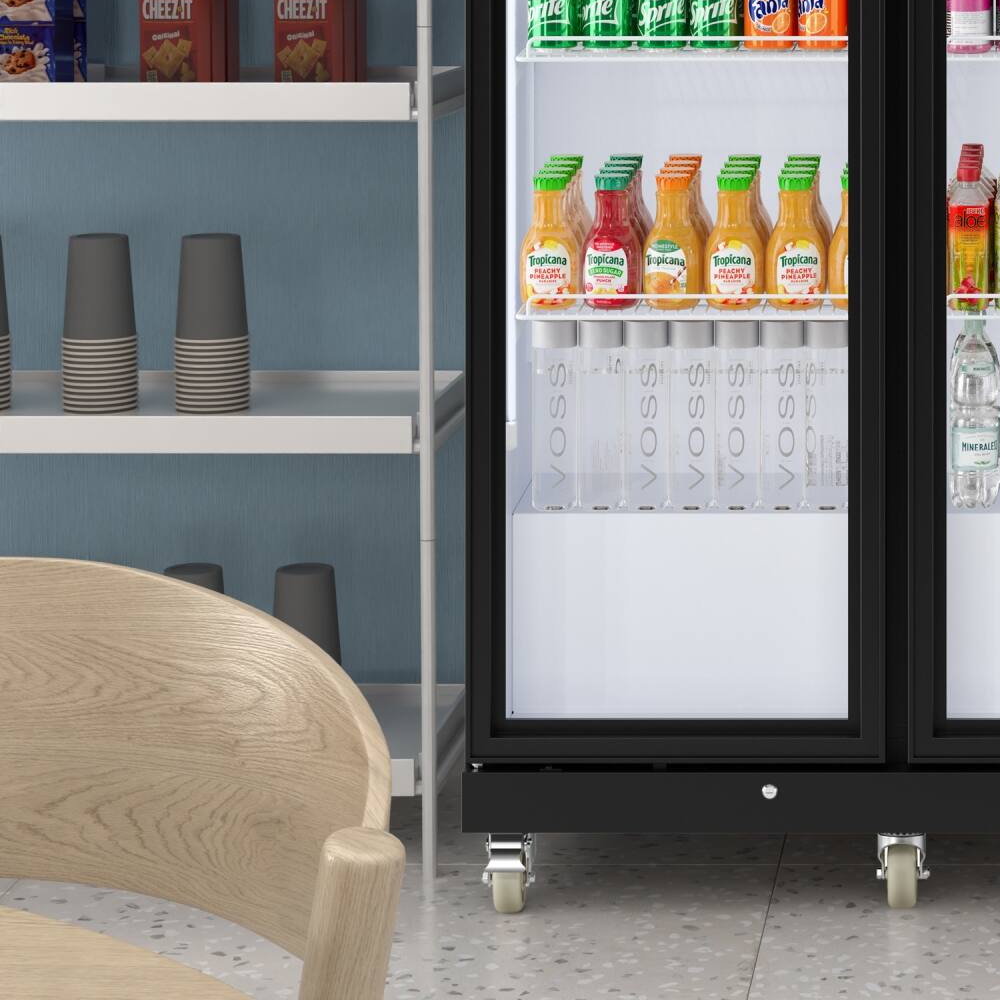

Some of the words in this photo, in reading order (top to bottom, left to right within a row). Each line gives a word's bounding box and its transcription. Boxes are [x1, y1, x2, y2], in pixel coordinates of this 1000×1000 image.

[955, 211, 986, 228] aloe
[528, 254, 567, 267] Tropicana
[587, 254, 624, 267] Tropicana
[646, 254, 685, 267] Tropicana
[713, 254, 751, 267] Tropicana
[780, 254, 818, 267] Tropicana
[603, 268, 623, 277] SUGAR
[550, 362, 567, 490] VOSS
[640, 362, 658, 490] VOSS
[688, 362, 705, 490] VOSS
[728, 362, 745, 490] VOSS
[778, 362, 795, 490] VOSS
